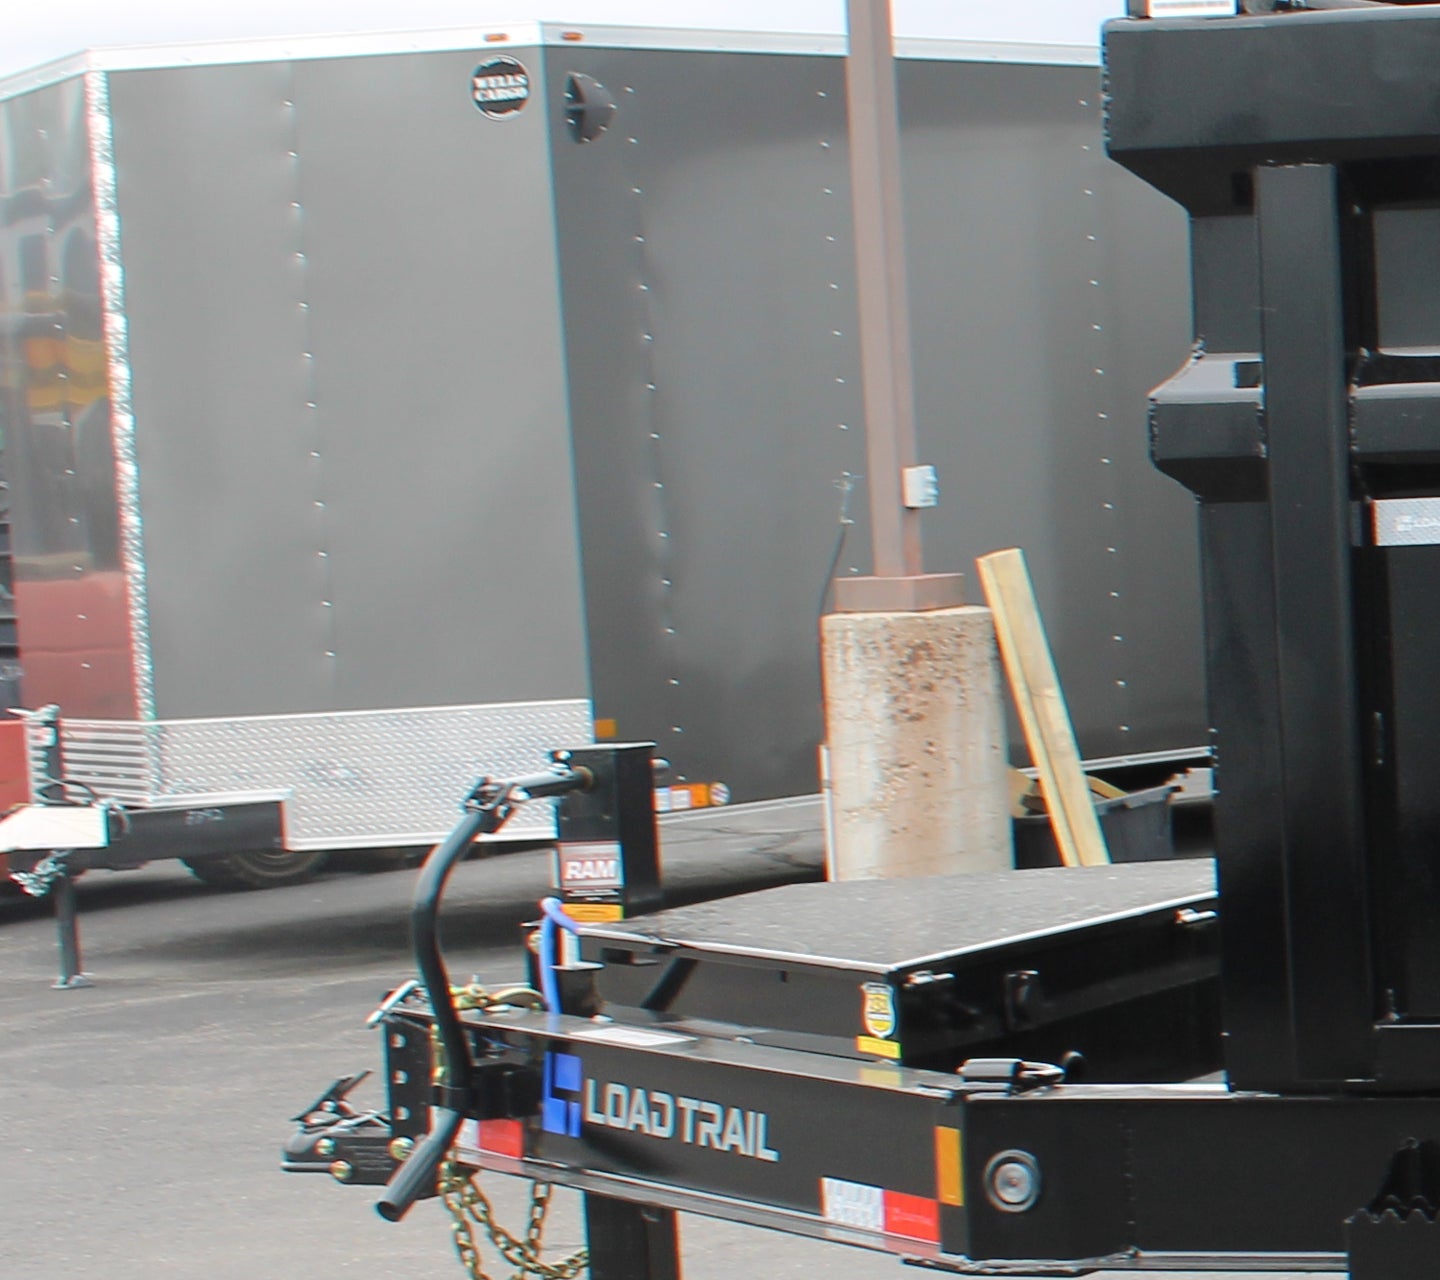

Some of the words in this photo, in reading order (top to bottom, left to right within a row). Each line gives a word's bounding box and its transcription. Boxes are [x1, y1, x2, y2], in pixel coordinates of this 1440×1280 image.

[564, 860, 617, 879] RAM
[584, 1077, 675, 1139] LOAD
[676, 1095, 779, 1162] TRAIL
